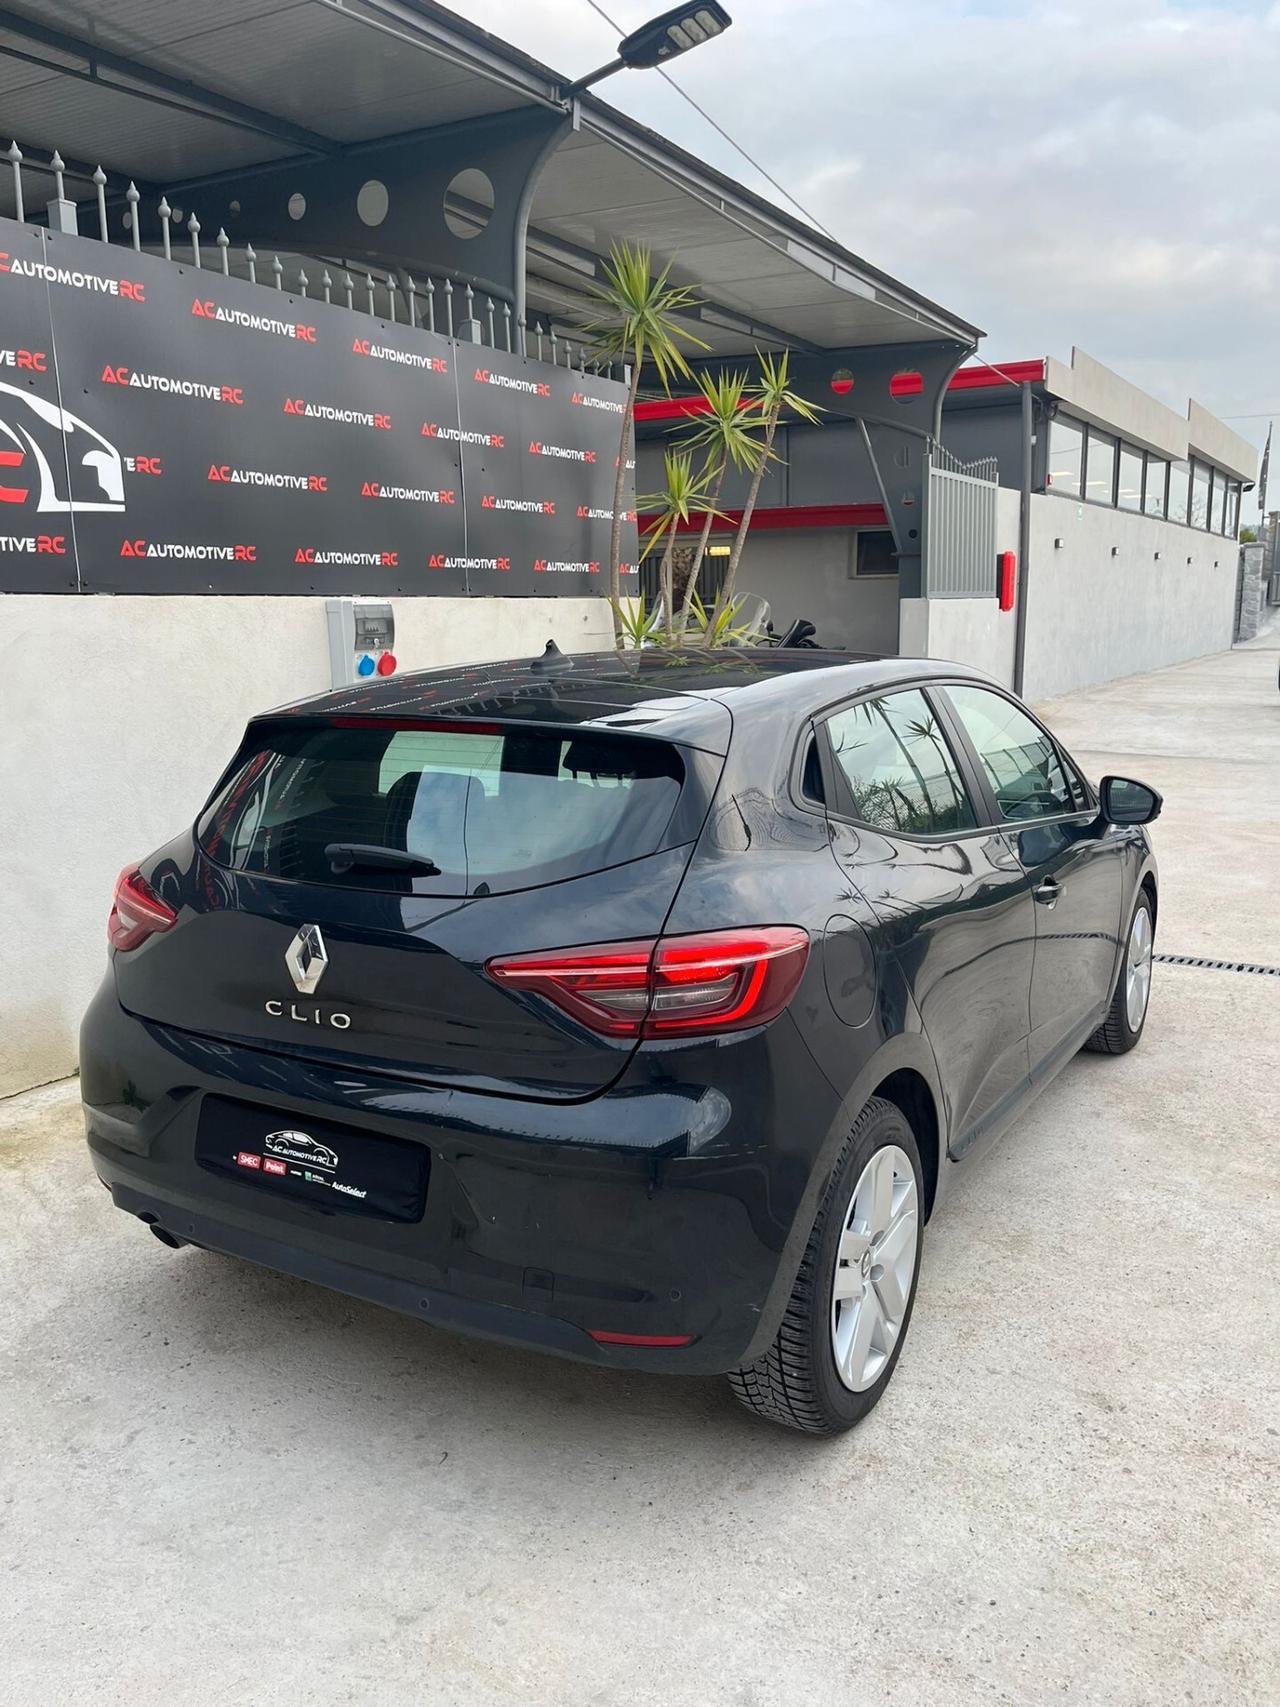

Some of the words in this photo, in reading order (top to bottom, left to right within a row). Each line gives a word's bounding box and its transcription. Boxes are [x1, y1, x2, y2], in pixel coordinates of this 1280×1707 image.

[192, 299, 317, 343] ACAUTOMOTIVERC
[352, 337, 448, 373] ACAUTOMOTIVERC
[101, 365, 244, 406] ACAUTOMOTIVERC
[283, 398, 391, 430] ACAUTOMOTIVERC
[571, 392, 634, 416] ACAUTOMOTIVE
[421, 423, 504, 449] ACAUTOMOTIVERC
[124, 456, 163, 476] ERC
[208, 464, 328, 492] ACAUTOMOTIVERC
[361, 482, 455, 505] ACAUTOMOTIVERC
[120, 538, 257, 562] ACAUTOMOTIVERC
[294, 547, 398, 567] ACAUTOMOTIVERC
[428, 554, 511, 571] ACAUTOMOTIVERC
[265, 1000, 351, 1029] CLIO
